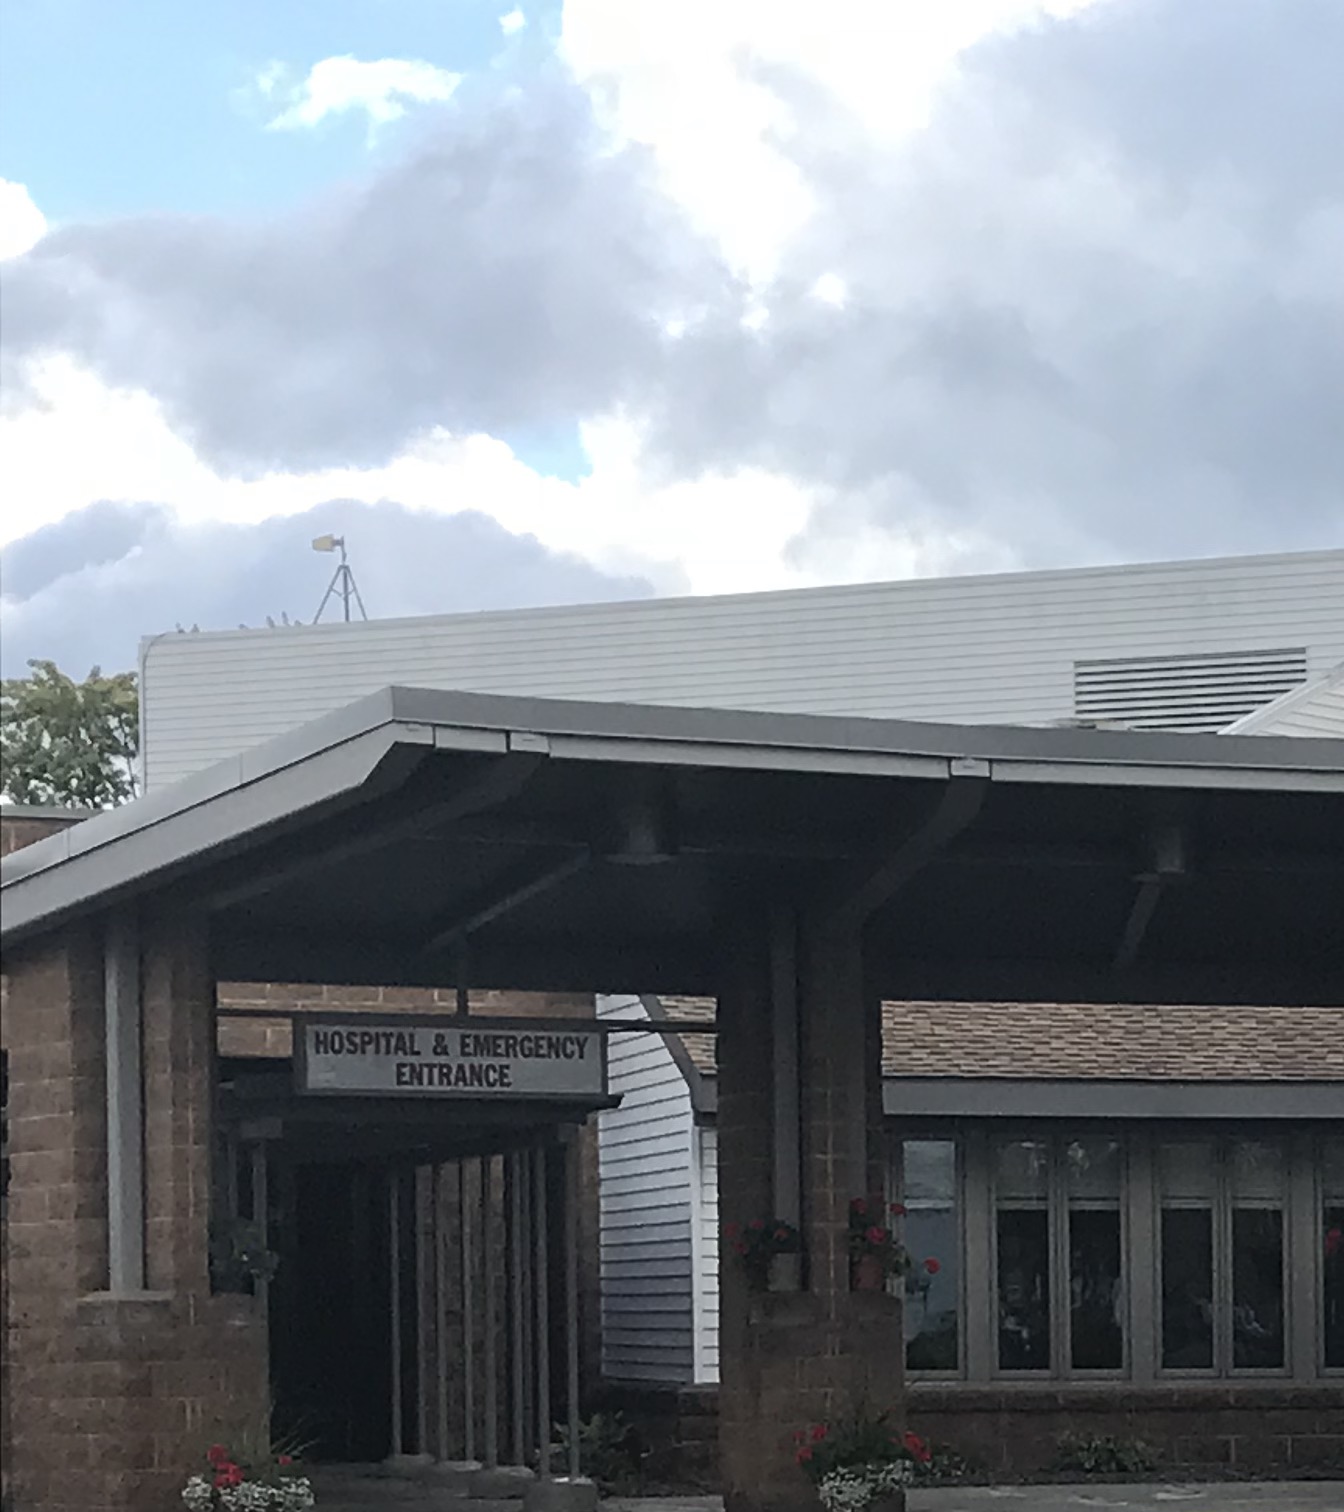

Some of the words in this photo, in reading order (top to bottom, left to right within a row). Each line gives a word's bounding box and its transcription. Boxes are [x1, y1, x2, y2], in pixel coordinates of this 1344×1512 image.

[314, 1029, 421, 1056] HOSPITAL
[432, 1032, 449, 1056] &
[460, 1033, 590, 1060] EMERGENCY
[395, 1062, 513, 1088] ENTRANCE
